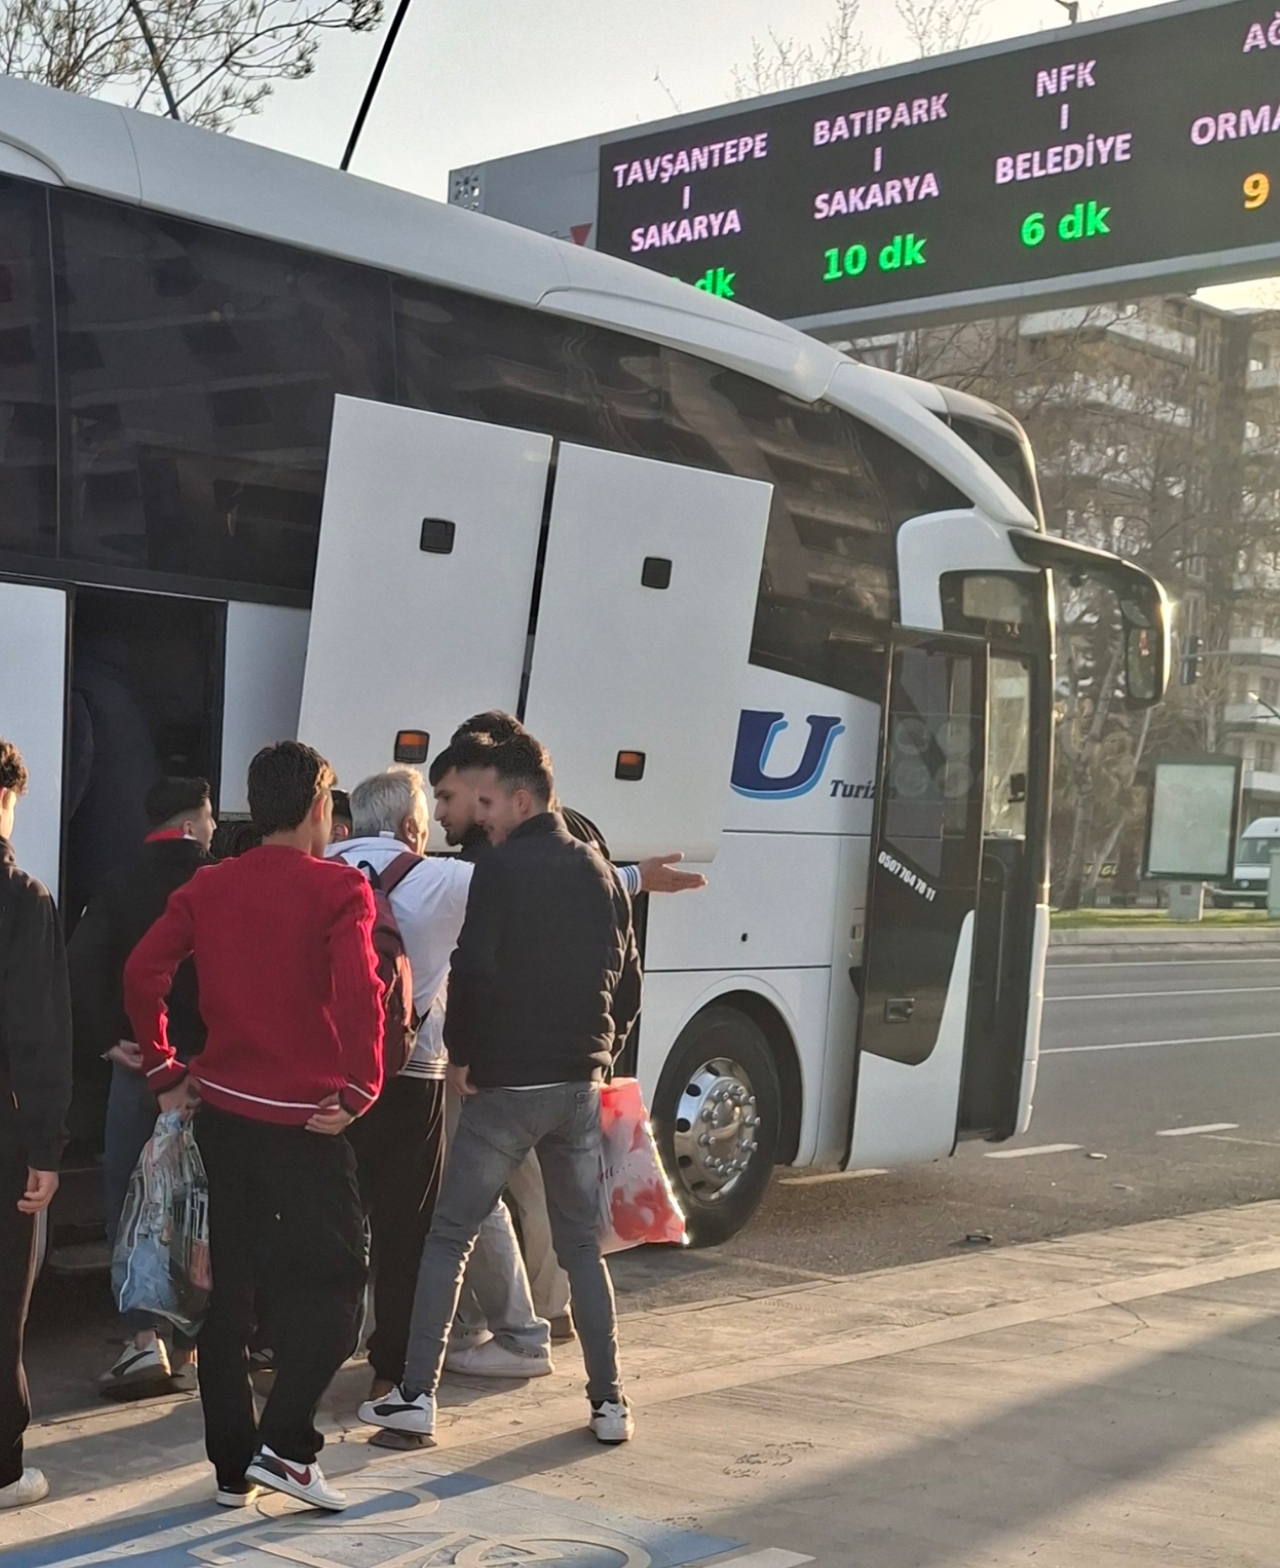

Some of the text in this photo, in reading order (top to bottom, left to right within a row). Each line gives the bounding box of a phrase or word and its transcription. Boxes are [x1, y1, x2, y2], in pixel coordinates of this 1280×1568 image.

[1036, 59, 1097, 98] NFK
[813, 92, 949, 147] BATIPARK
[613, 132, 768, 188] TAVŞANTEPE
[995, 132, 1132, 184] BELEDİYE
[813, 172, 940, 220] SAKARYA
[1242, 172, 1271, 209] 9
[630, 208, 741, 253] SAKARYA
[1021, 200, 1111, 246] 6 dk
[823, 233, 927, 281] 10 dk
[730, 709, 846, 800] U
[925, 887, 937, 902] 11
